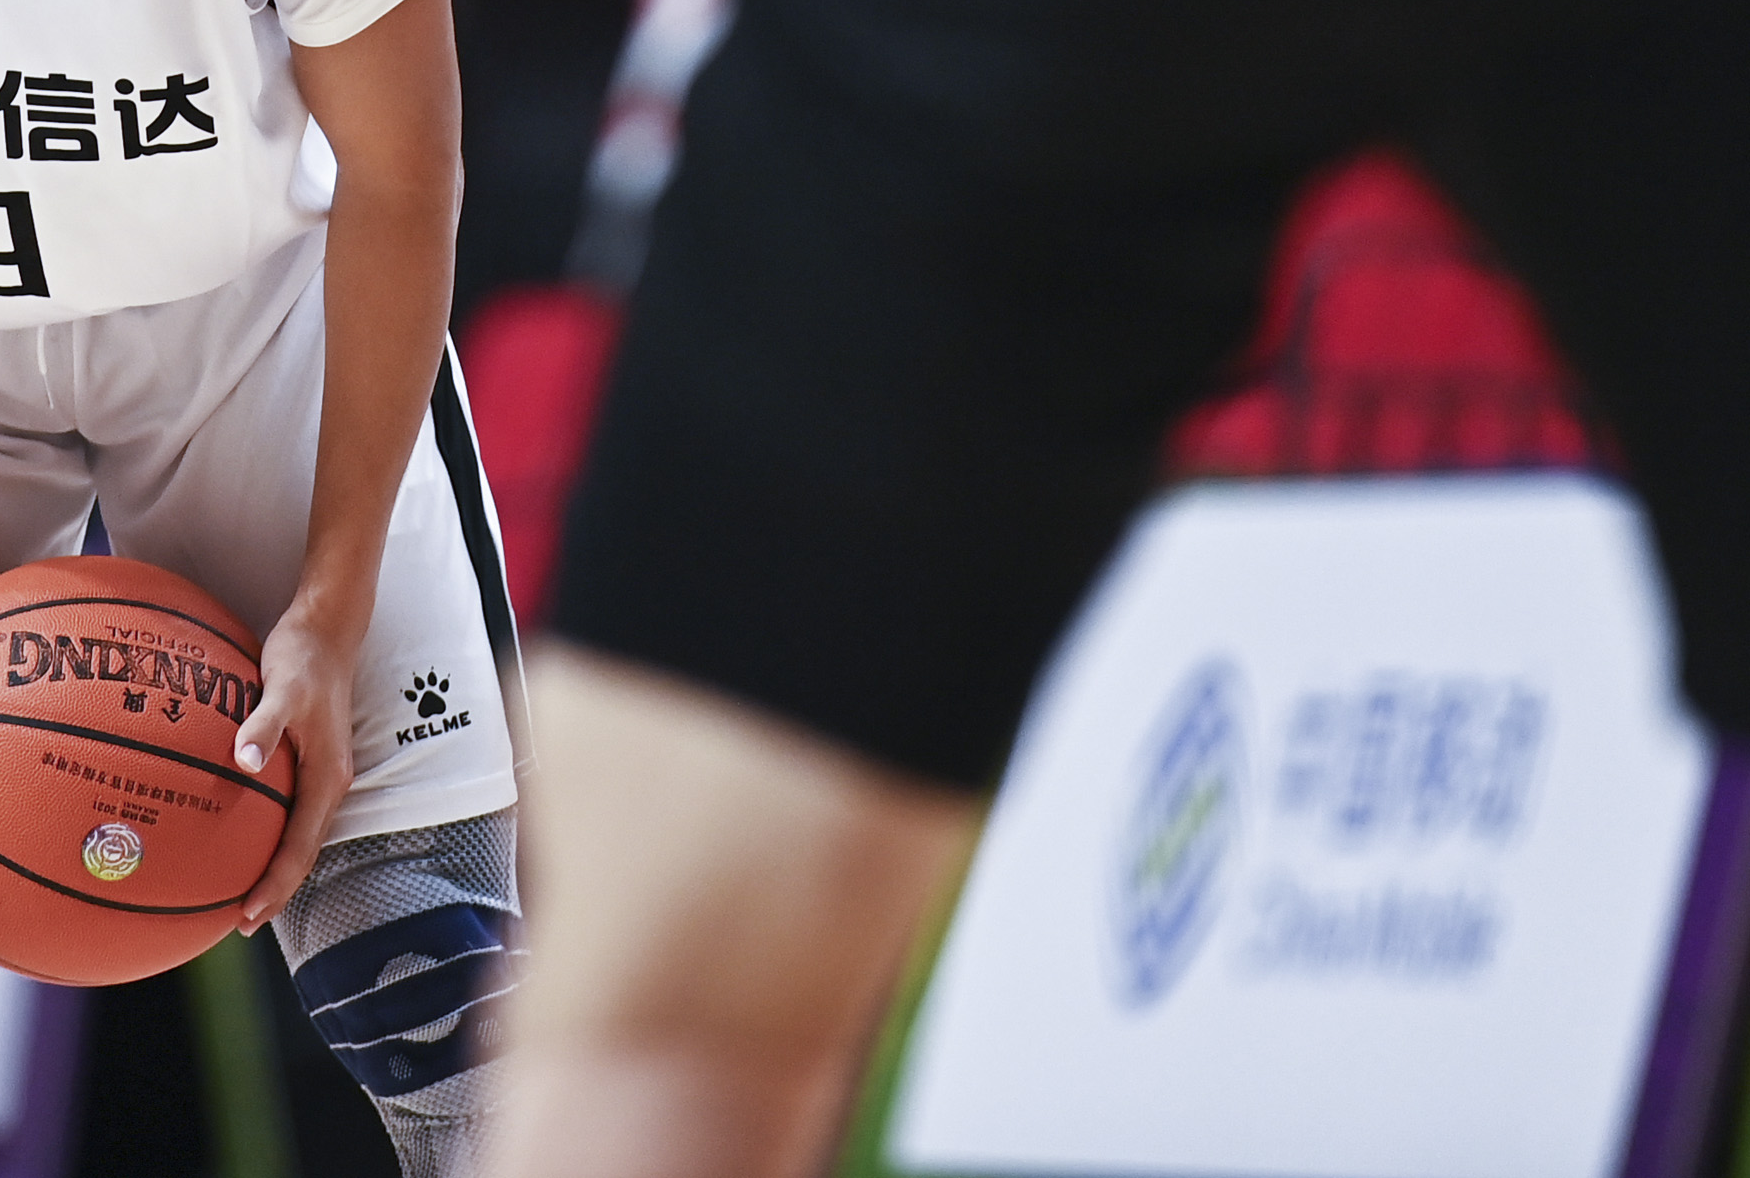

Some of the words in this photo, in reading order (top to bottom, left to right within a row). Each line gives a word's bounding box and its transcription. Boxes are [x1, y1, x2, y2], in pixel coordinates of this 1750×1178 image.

[105, 625, 205, 659] OFFICIAL
[396, 710, 471, 746] KELME
[93, 800, 117, 815] 2021
